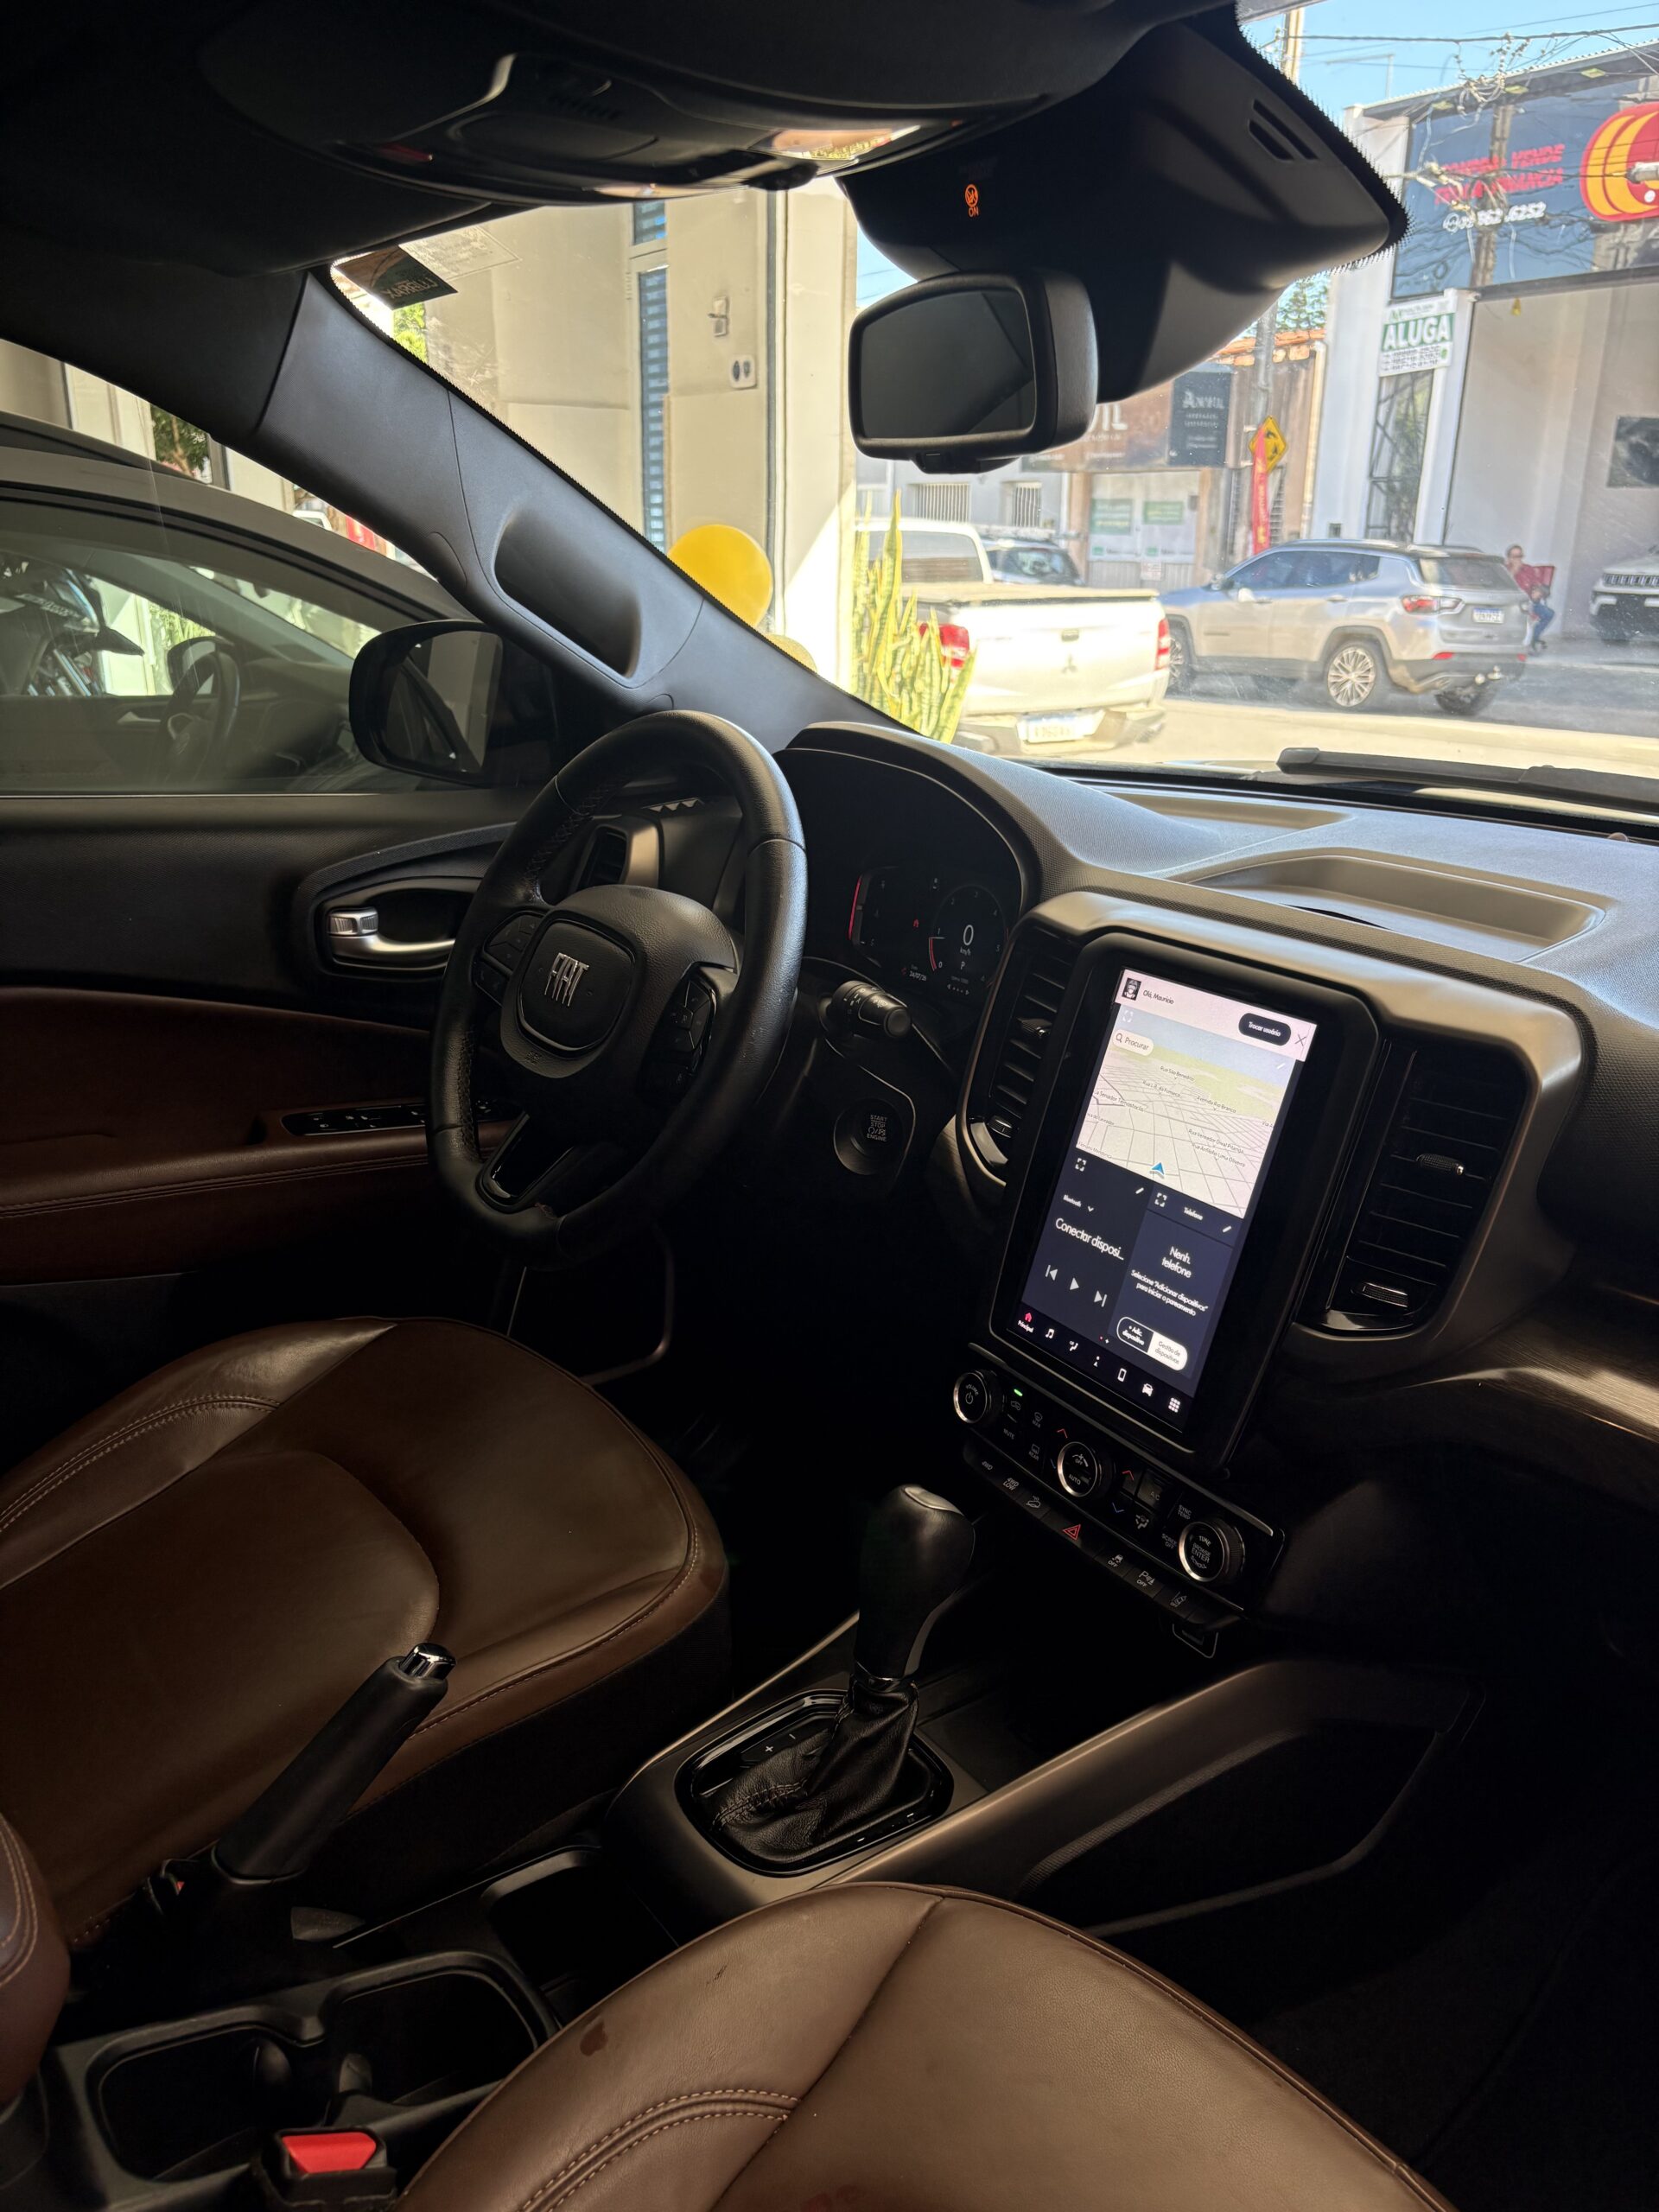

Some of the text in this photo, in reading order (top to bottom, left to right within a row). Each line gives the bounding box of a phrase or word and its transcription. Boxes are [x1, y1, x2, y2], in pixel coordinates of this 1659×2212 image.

[969, 207, 979, 217] ON
[1382, 315, 1452, 352] ALUGA
[963, 925, 975, 945] 0
[959, 947, 971, 957] km/h
[544, 952, 589, 1007] FIAT
[1248, 1020, 1263, 1033] Trocar
[1124, 1036, 1149, 1052] Procurar
[867, 1133, 887, 1141] ENGINE
[1183, 1206, 1204, 1221] Telefone
[1055, 1217, 1091, 1244] Conectar
[1169, 1246, 1192, 1265] Nenh.
[1161, 1256, 1192, 1279] telefone
[1130, 1269, 1154, 1287] Selecione
[1136, 1282, 1148, 1293] para
[1147, 1287, 1162, 1300] iniciar
[1166, 1297, 1197, 1317] pareamento
[1017, 1319, 1034, 1333] Principal
[1158, 1340, 1181, 1357] Gestão de
[1154, 1347, 1180, 1365] dispositivos
[965, 1383, 979, 1396] VOLUME
[1003, 1428, 1015, 1440] MUTE
[982, 1461, 994, 1471] 4WD
[1002, 1481, 1016, 1491] LOW
[1007, 1477, 1020, 1487] 4WD
[1068, 1473, 1081, 1485] AUTO
[1179, 1504, 1192, 1516] SYNC
[1198, 1535, 1211, 1547] TUNE
[1192, 1548, 1211, 1563] ENTER
[1136, 1579, 1147, 1587] OFF
